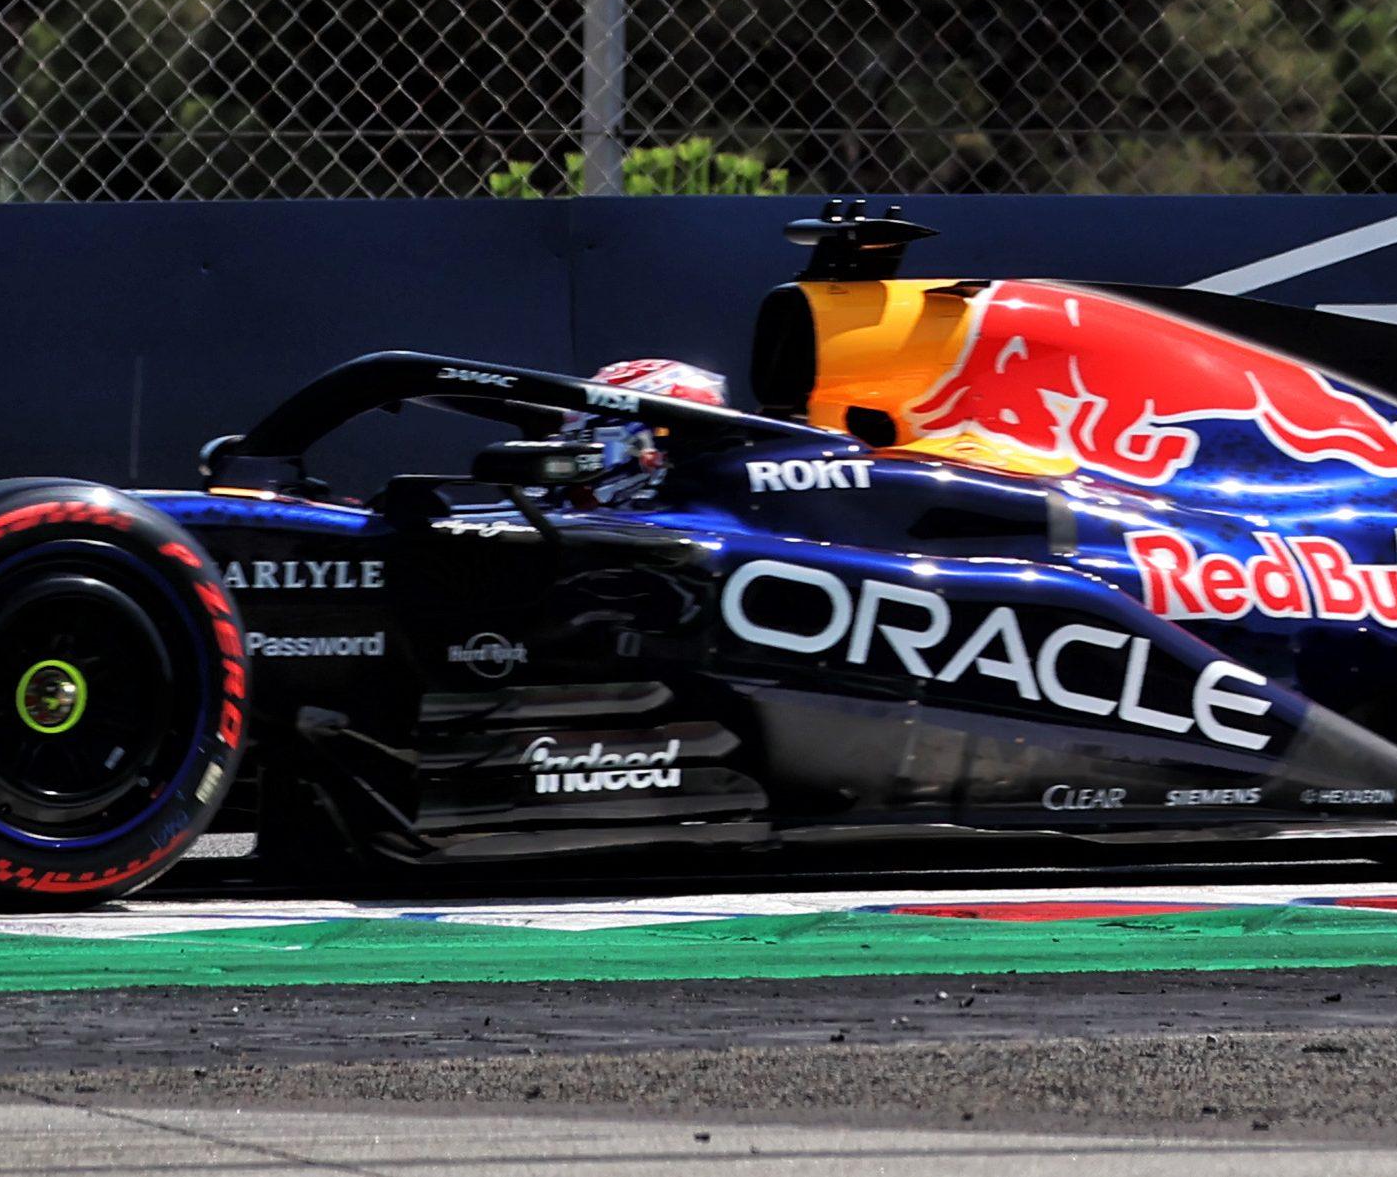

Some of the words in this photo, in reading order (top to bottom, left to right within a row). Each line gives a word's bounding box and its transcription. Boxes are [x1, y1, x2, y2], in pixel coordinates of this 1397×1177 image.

[745, 460, 875, 492] ROKT
[219, 561, 385, 588] ARLYLE
[721, 559, 1272, 750] ORACLE
[521, 736, 681, 793] indeed
[1042, 784, 1127, 810] CLEAR
[1164, 788, 1262, 806] SIEMENS
